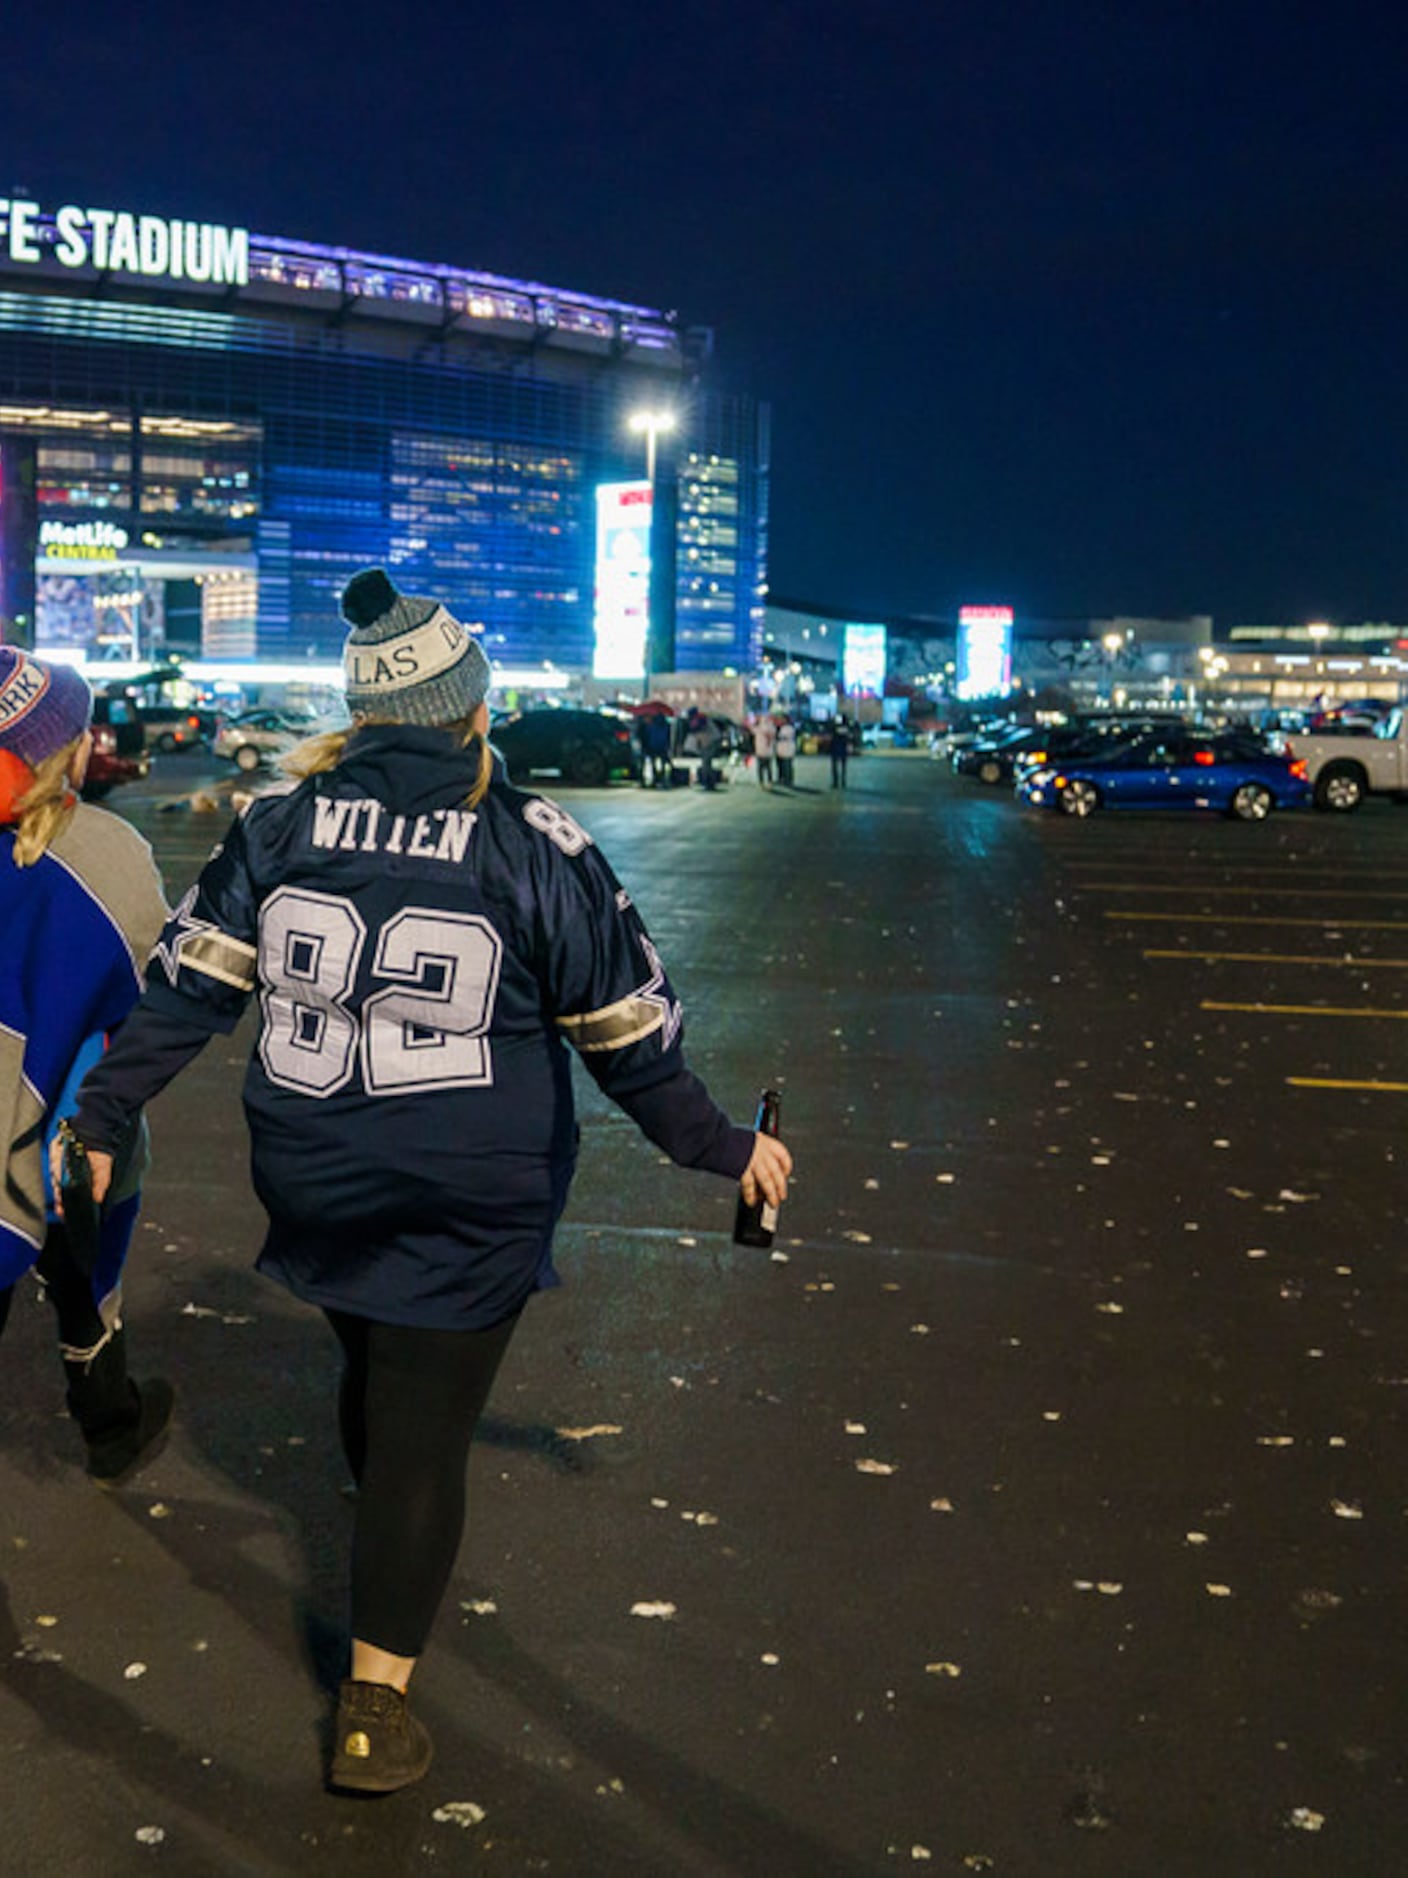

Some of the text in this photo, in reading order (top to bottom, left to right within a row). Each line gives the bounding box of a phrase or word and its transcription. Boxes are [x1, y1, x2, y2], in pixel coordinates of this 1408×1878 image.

[55, 205, 250, 287] STADIUM
[40, 521, 129, 549] MetLife
[46, 543, 117, 560] CENTRAL
[257, 884, 503, 1099] 82
